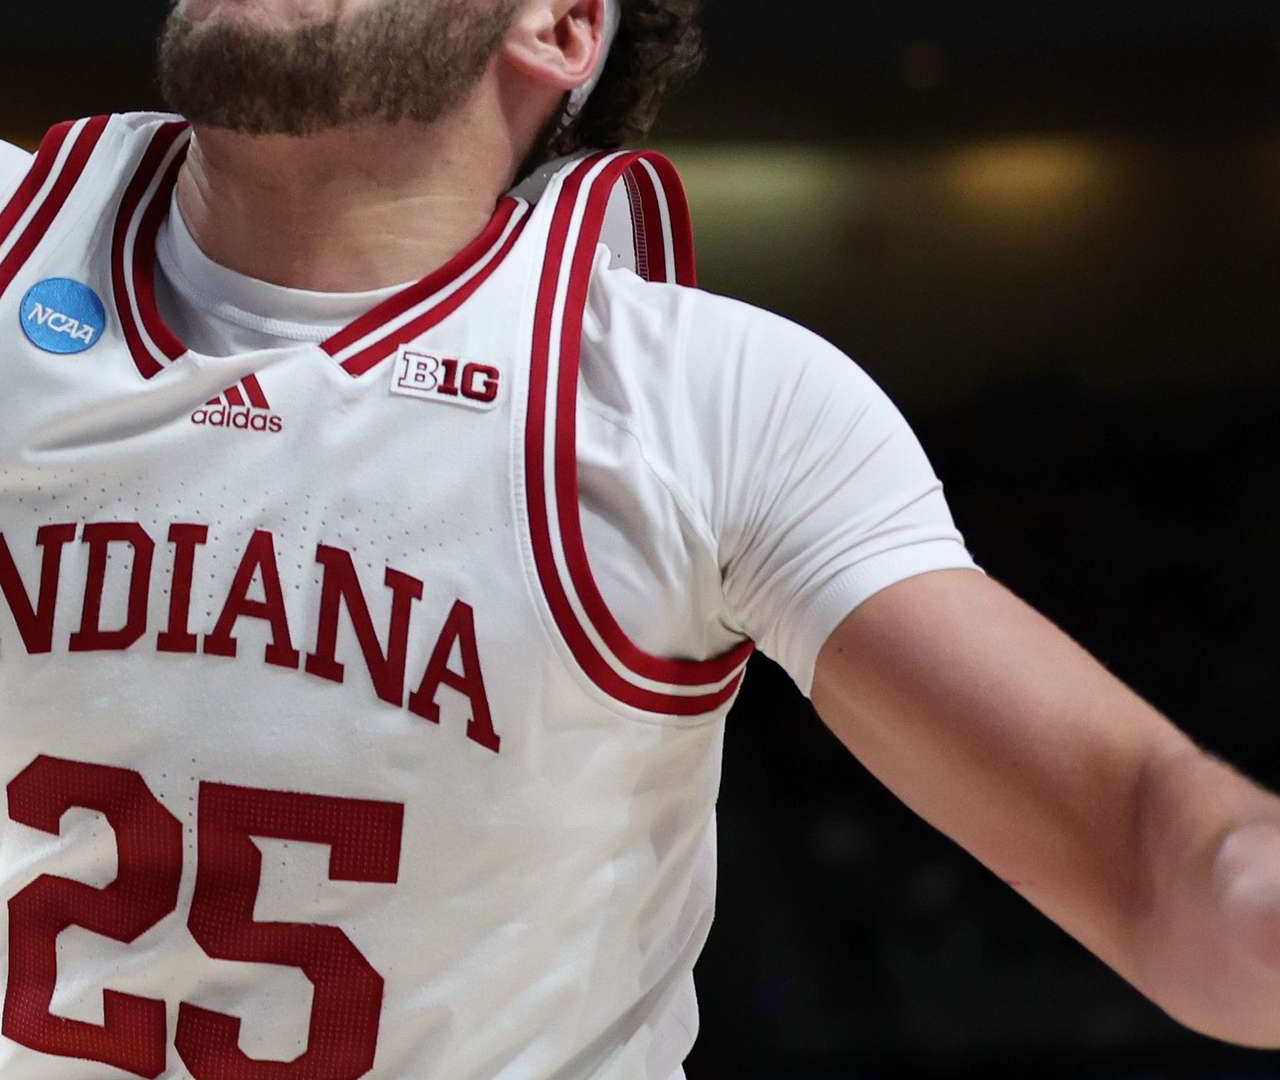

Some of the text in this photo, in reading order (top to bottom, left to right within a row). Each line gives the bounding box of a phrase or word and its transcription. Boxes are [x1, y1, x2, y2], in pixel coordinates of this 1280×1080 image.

[27, 302, 95, 344] NCAA
[191, 406, 283, 433] adidas
[2, 753, 405, 1080] 25
